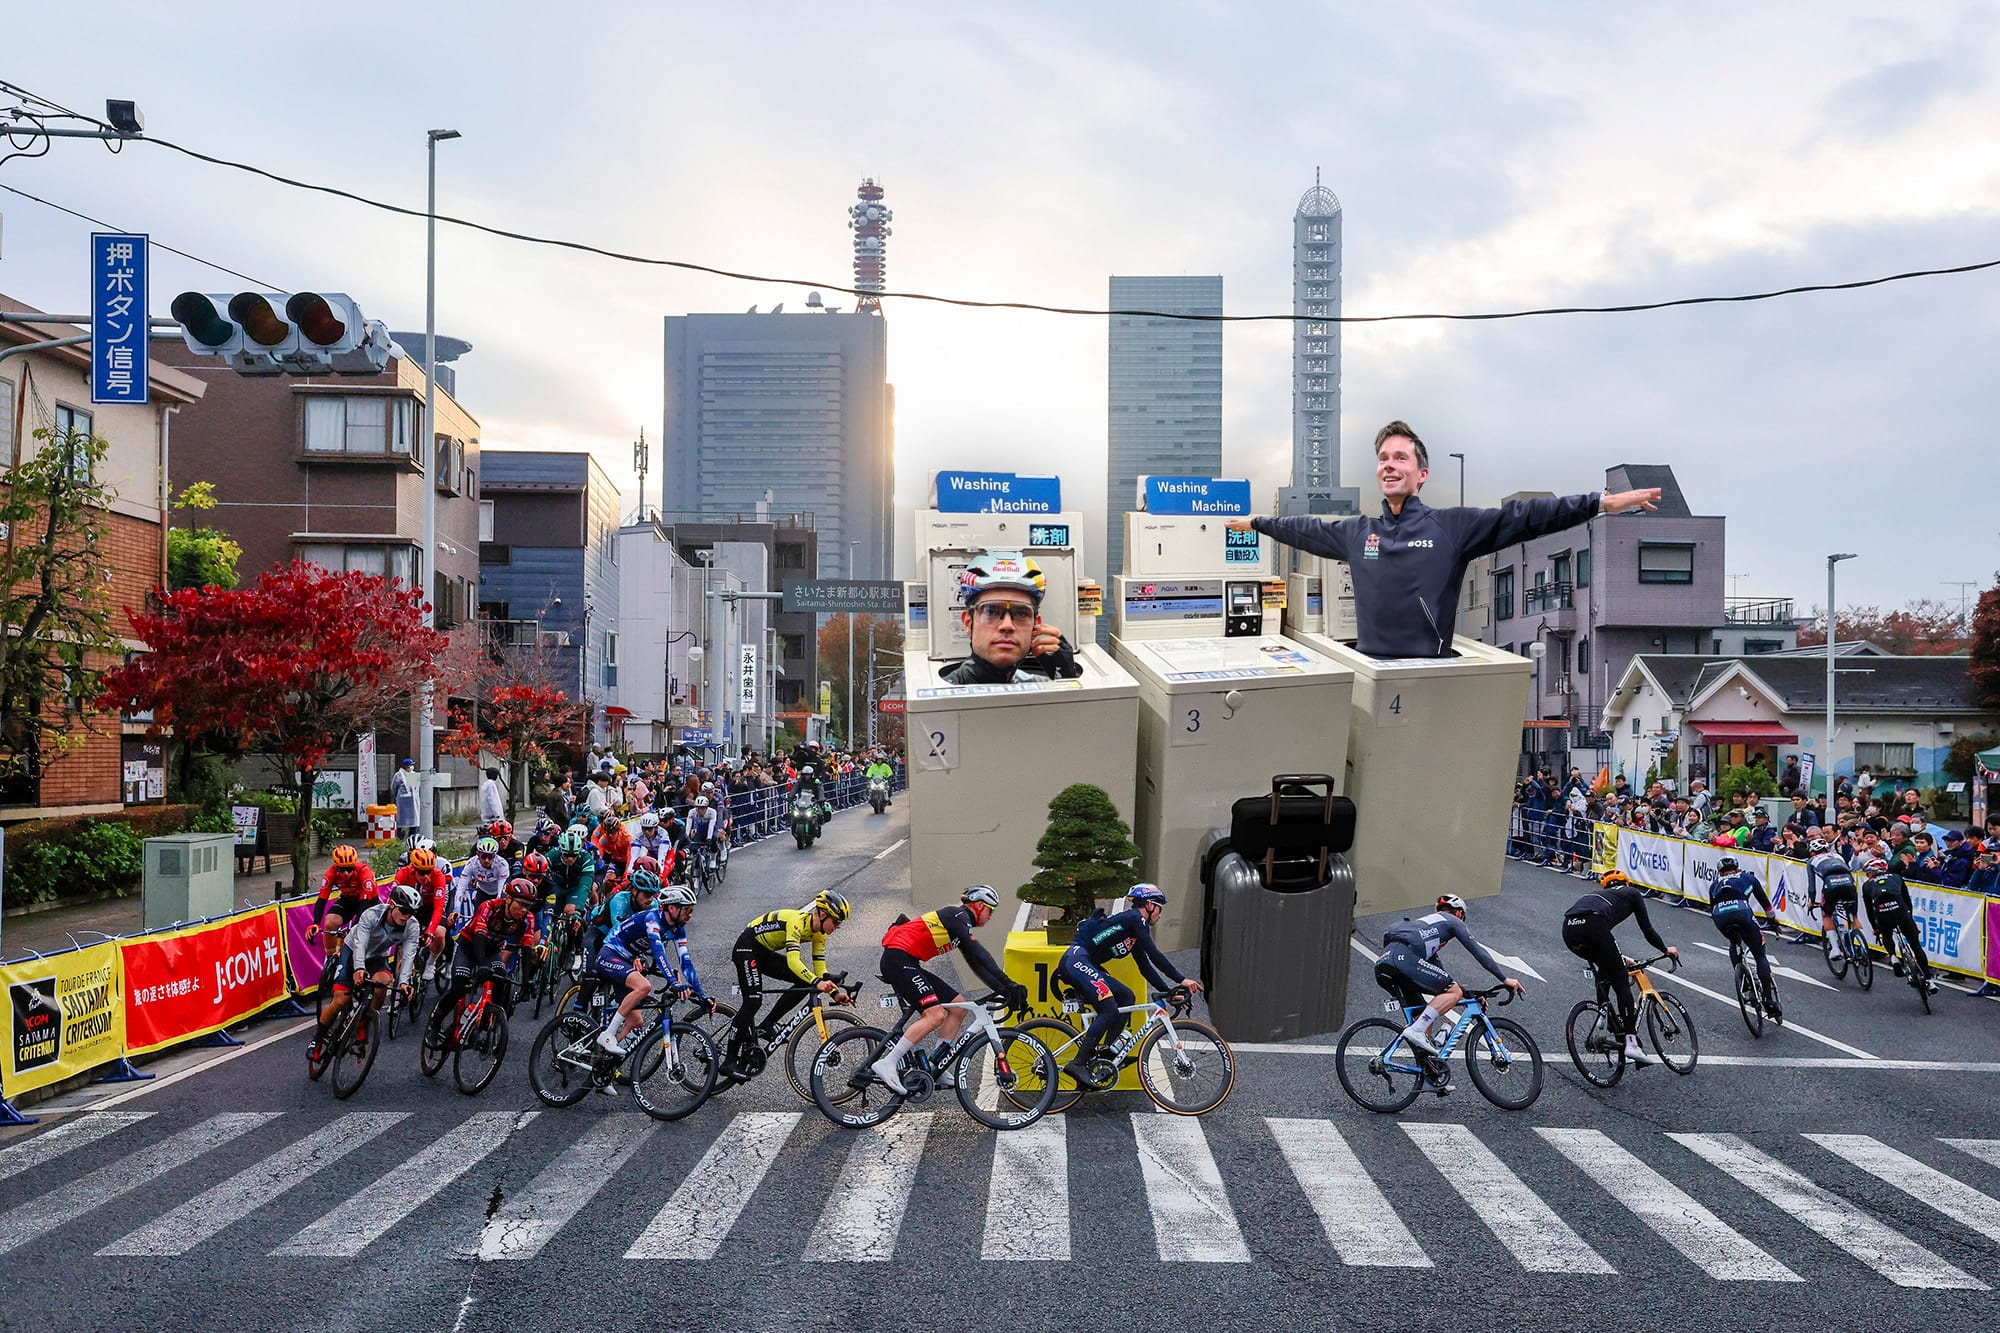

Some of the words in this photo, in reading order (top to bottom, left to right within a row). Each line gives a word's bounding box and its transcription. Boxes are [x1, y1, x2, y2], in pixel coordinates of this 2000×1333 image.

[106, 242, 134, 395] 押ボタン信号
[950, 476, 1010, 493] Washing
[1157, 481, 1208, 495] Washing
[990, 498, 1049, 511] Machine
[1192, 500, 1241, 512] Machine
[1031, 527, 1067, 546] 洗剤
[1228, 529, 1257, 545] 洗剤
[1407, 539, 1434, 548] BOSS
[1226, 549, 1259, 561] 自動投入
[794, 585, 901, 599] さいたま新都心駅東口
[743, 652, 754, 699] 永井歯科
[1389, 693, 1402, 714] 4
[1186, 709, 1201, 733] 3
[929, 731, 946, 757] 2
[213, 947, 263, 1004] J:COM
[263, 936, 280, 976] 光
[1073, 961, 1099, 980] BORA
[61, 978, 76, 993] TOUR
[76, 974, 85, 988] DE
[86, 967, 111, 985] FRANCE
[911, 974, 930, 994] UAE
[62, 984, 110, 1020] SAITAMA
[885, 999, 893, 1007] 31
[1066, 1004, 1075, 1012] 21
[65, 1011, 112, 1046] CRITERIUM
[937, 1033, 970, 1070] COLNAGO
